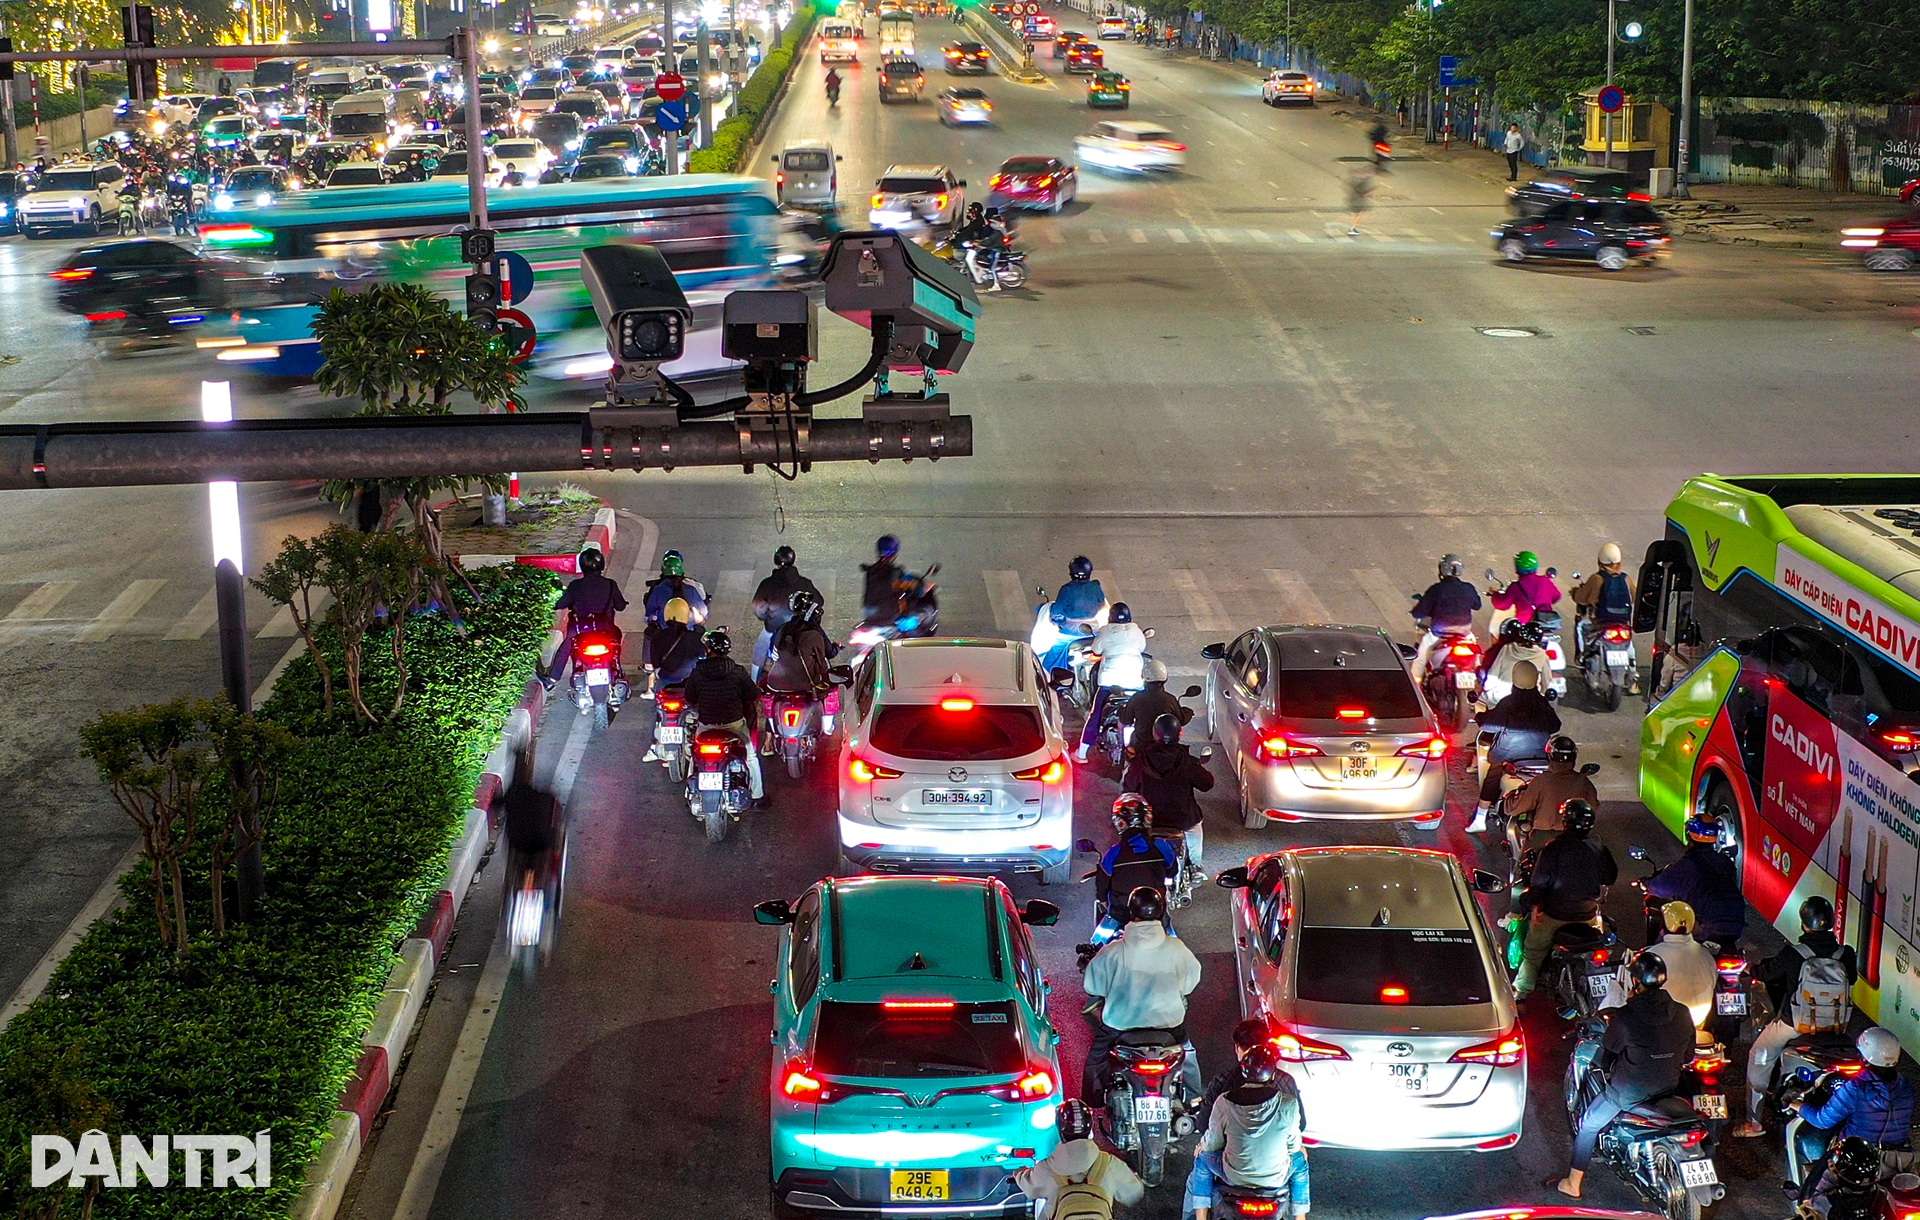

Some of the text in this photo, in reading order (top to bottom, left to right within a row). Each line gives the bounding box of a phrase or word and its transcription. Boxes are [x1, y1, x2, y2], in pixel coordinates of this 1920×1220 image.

[1784, 568, 1802, 592] DÂY
[1803, 580, 1820, 602] CÁP
[1821, 591, 1843, 618] ĐIỆN
[1771, 713, 1834, 781] CADIVI
[1349, 757, 1368, 769] 30F
[928, 793, 986, 803] 30H-394.92
[1848, 758, 1920, 825] DÂY ĐIỆN KHÔNG
[1846, 781, 1876, 816] KHÔNG
[1877, 807, 1919, 849] HALOGEN
[1798, 811, 1815, 835] NAM
[1388, 1064, 1412, 1077] 30K
[1138, 1110, 1167, 1120] 017.66
[907, 1172, 932, 1185] 29E
[896, 1186, 943, 1199] 048.43
